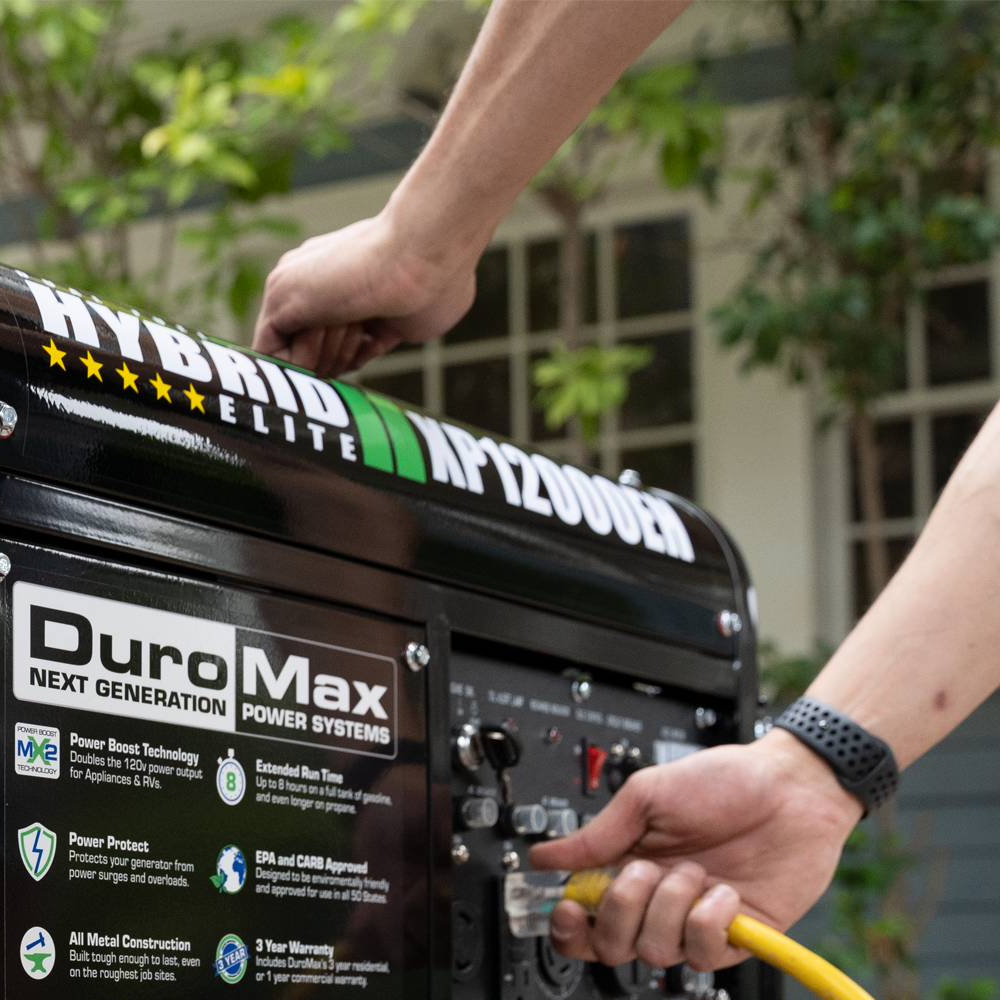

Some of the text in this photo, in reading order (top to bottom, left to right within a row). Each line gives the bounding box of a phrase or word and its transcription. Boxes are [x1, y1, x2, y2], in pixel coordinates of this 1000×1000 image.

[24, 278, 349, 428] HYBRID
[219, 394, 357, 462] ELITE
[30, 604, 388, 720] DuroMax
[30, 667, 390, 745] NEXT GENERATION POWER SYSTEMS
[18, 726, 57, 737] POWER BOOST
[18, 736, 57, 765] MX2
[70, 732, 199, 766] Power Boost Technology
[17, 764, 57, 774] TECHNOLOGY
[70, 751, 203, 781] Doubles the 120v power output
[256, 759, 343, 784] Extended Run Time
[70, 767, 162, 789] for Appliances & RVs.
[226, 772, 236, 791] 8
[256, 776, 267, 790] Up
[268, 778, 277, 789] to
[278, 780, 284, 790] 8
[286, 779, 307, 793] hours
[309, 784, 318, 795] on
[325, 785, 336, 798] full
[338, 788, 353, 799] tank
[355, 789, 363, 801] of
[256, 792, 270, 802] and
[272, 796, 289, 805] even
[291, 795, 314, 810] longer
[315, 799, 324, 809] on
[69, 832, 149, 852] Power Protect
[69, 850, 194, 872] Protects your generator from
[256, 850, 368, 875] EPA and CARB Approved
[69, 868, 189, 887] power surges and overloads.
[256, 867, 290, 883] Designed
[292, 871, 300, 881] to
[301, 871, 311, 883] be
[256, 883, 270, 894] and
[271, 885, 305, 898] approved
[307, 886, 318, 898] for
[319, 888, 332, 899] use
[333, 888, 340, 900] in
[341, 889, 350, 901] all
[69, 932, 191, 951] All Metal Construction
[256, 939, 334, 958] 3 Year Warranty
[70, 950, 200, 967] Built tough enough to last, even
[218, 948, 245, 970] 3 YEAR
[256, 955, 287, 968] Includes
[328, 958, 334, 970] 3
[335, 962, 351, 972] year
[70, 967, 176, 982] on the roughest job sites.
[256, 972, 265, 981] or
[267, 970, 271, 981] 1
[273, 972, 289, 985] year
[291, 972, 333, 984] commercial
